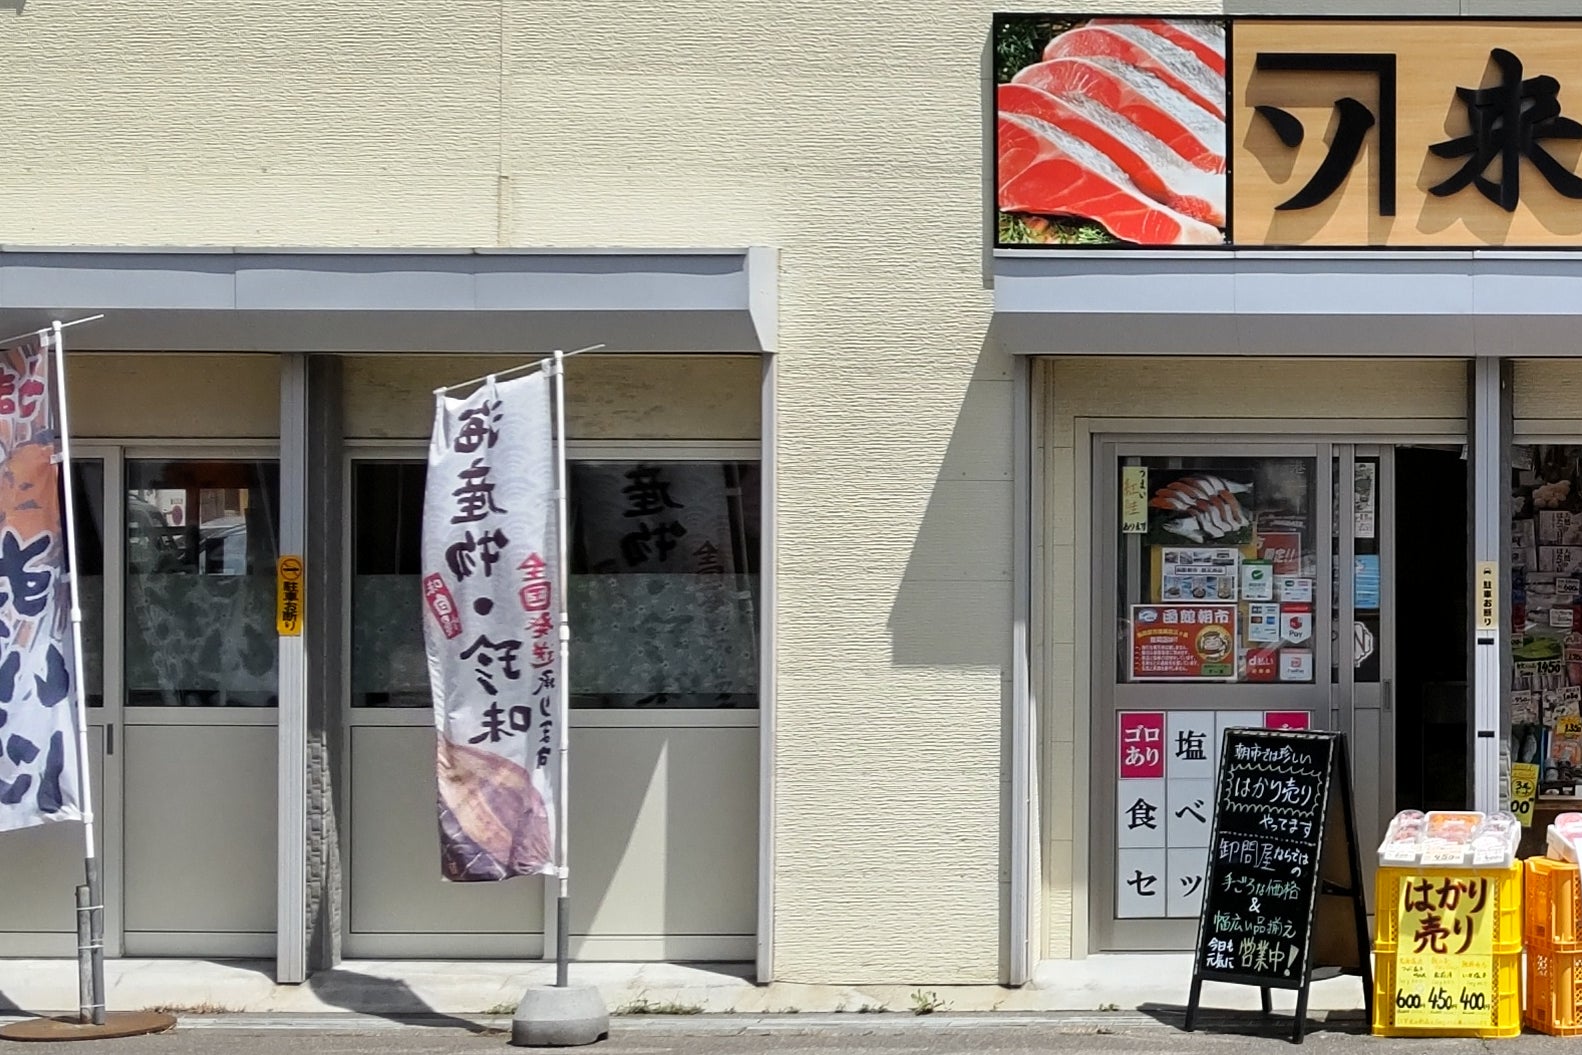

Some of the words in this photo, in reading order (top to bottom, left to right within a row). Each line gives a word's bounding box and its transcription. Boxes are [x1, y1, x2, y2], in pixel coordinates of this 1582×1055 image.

[282, 581, 300, 632] 駐車お断り
[1175, 731, 1208, 761] 塩
[1234, 743, 1313, 766] 朝市では珍しい
[1234, 776, 1314, 807] はかり売り
[1260, 815, 1313, 838] やってます
[1223, 872, 1302, 900] 手ごろな価格
[1404, 877, 1489, 914] はかり
[1249, 898, 1262, 914] &
[1213, 914, 1298, 939] 幅広い品揃え
[1412, 916, 1475, 955] 売り
[1206, 937, 1235, 952] 今日も
[1238, 936, 1300, 978] 営業中!
[1205, 951, 1235, 970] 元気に
